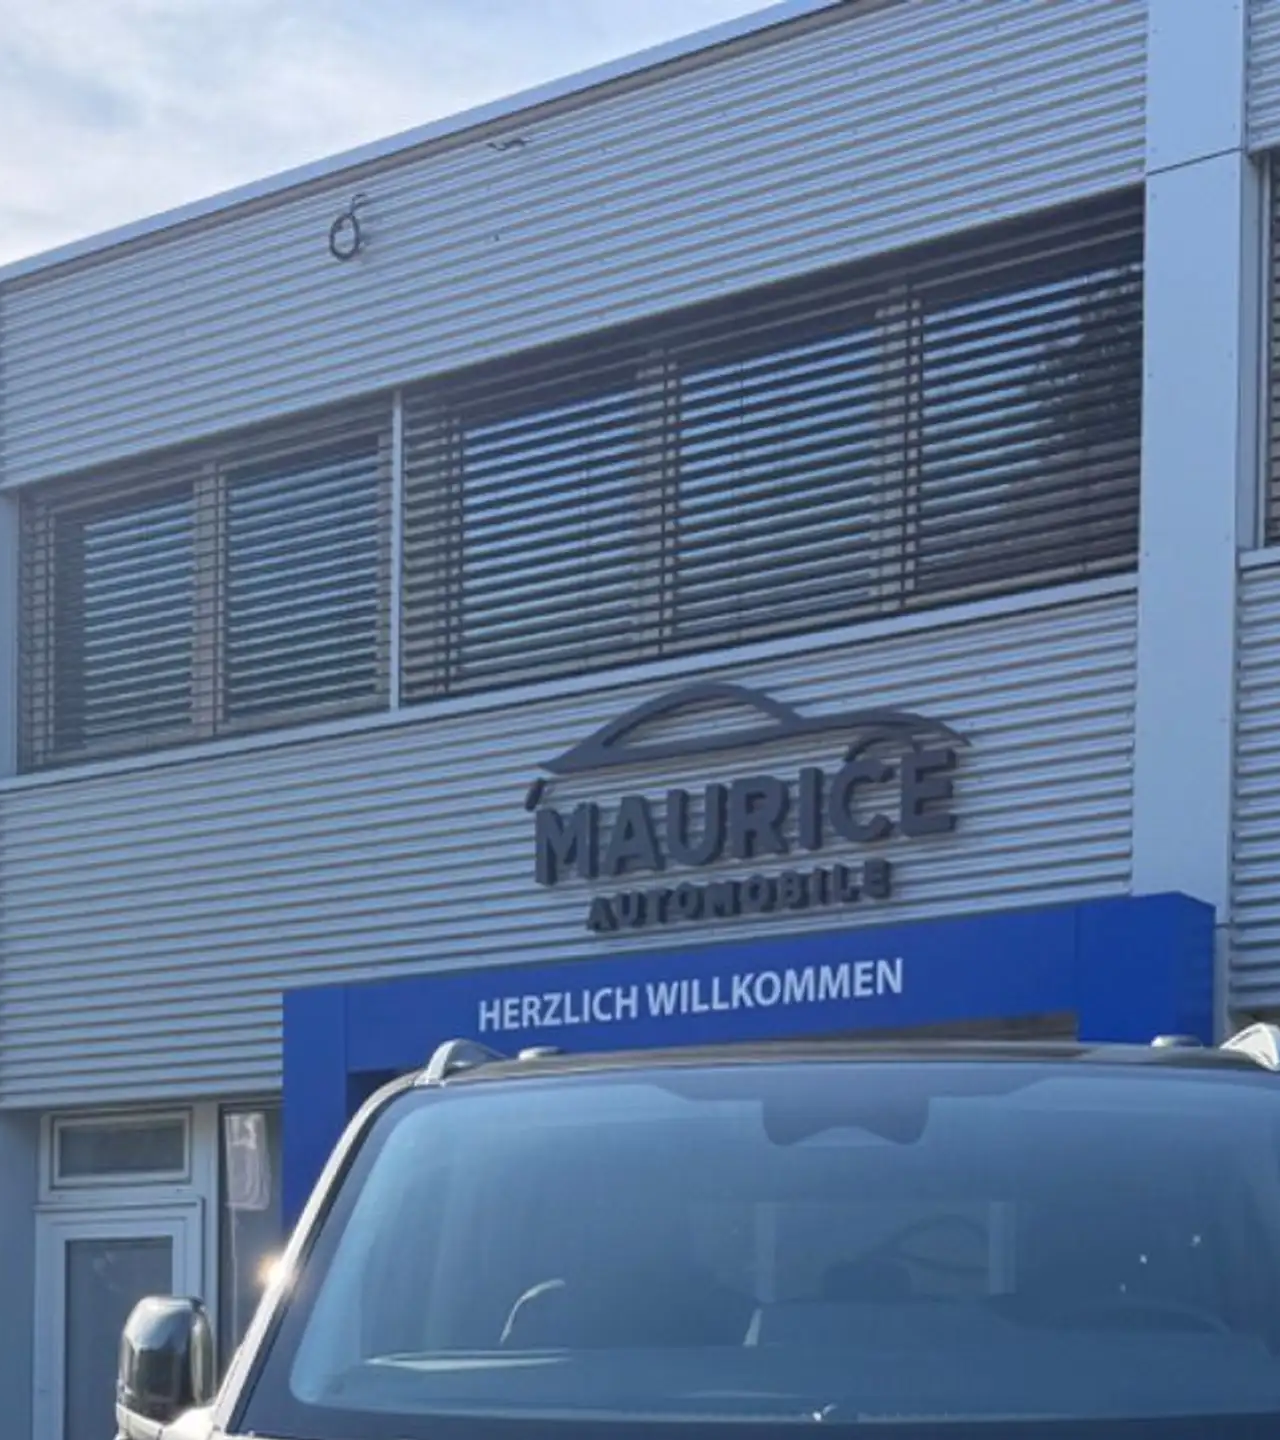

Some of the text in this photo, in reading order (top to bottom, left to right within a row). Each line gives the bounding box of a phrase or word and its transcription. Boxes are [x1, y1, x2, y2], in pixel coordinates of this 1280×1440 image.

[534, 746, 958, 885] MAURICE
[587, 856, 893, 932] AUTOMOBILE
[478, 957, 904, 1032] HERZLICH WILLKOMMEN
